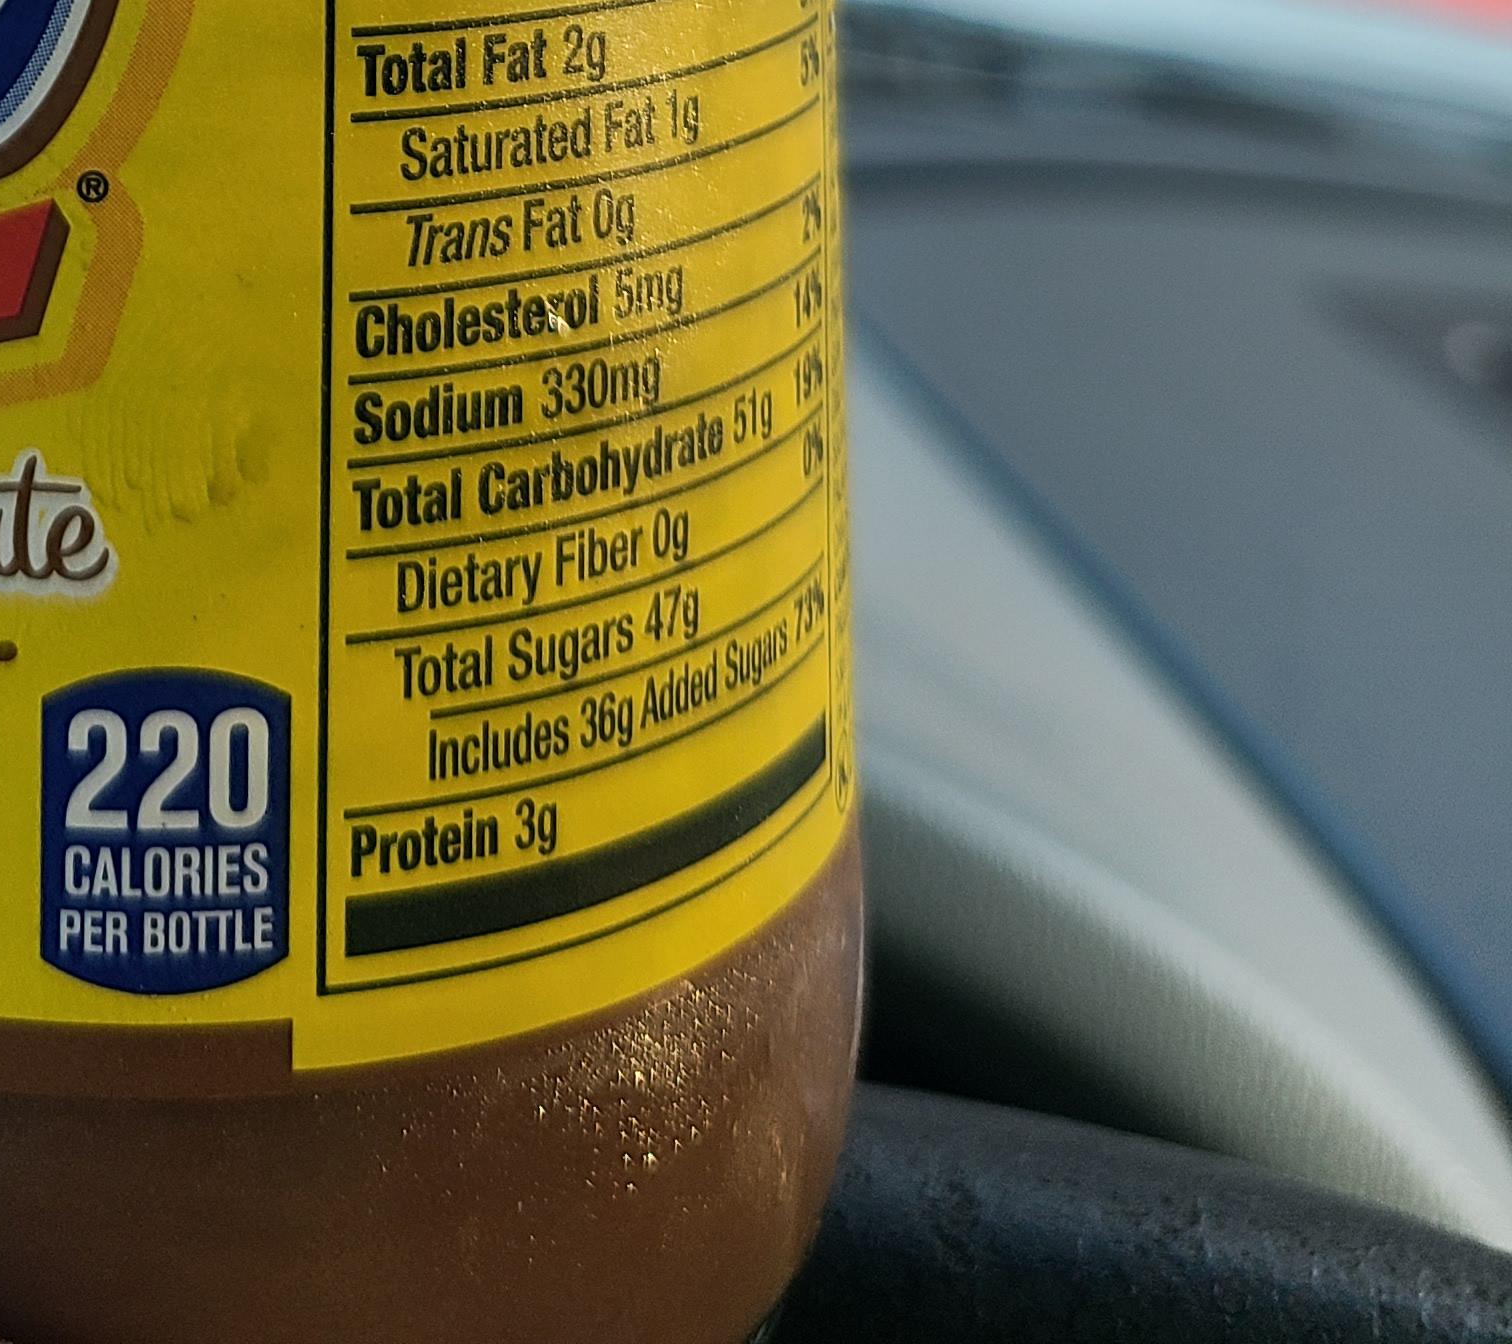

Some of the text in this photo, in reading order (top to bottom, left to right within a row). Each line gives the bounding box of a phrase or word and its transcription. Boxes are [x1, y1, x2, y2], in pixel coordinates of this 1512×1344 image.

[357, 37, 467, 97] Total
[482, 27, 547, 86] Fat
[562, 24, 607, 81] 2g
[400, 113, 590, 182] Saturated
[604, 96, 654, 152] Fat
[669, 89, 701, 142] 1g
[407, 187, 636, 267] Trans Fat 0g
[357, 275, 599, 359] Cholesterol
[614, 264, 685, 319] 5mg
[354, 381, 523, 445] Sodium
[541, 352, 662, 419] 330mg
[353, 471, 462, 532] Total
[478, 411, 724, 513] Carbohydrate
[733, 387, 772, 444] 51g
[396, 552, 542, 613] Dietary
[555, 525, 644, 586] Fiber
[653, 508, 689, 561] 0g
[395, 586, 699, 699] Total Sugars 47g
[429, 713, 569, 780] Includes
[580, 691, 634, 745] 36g
[641, 648, 717, 727] Added
[725, 617, 787, 691] Sugars
[66, 707, 270, 831] 220
[64, 843, 270, 898] CALORIES
[350, 797, 557, 877] Protein 3g
[59, 907, 275, 955] PER BOTTLE
